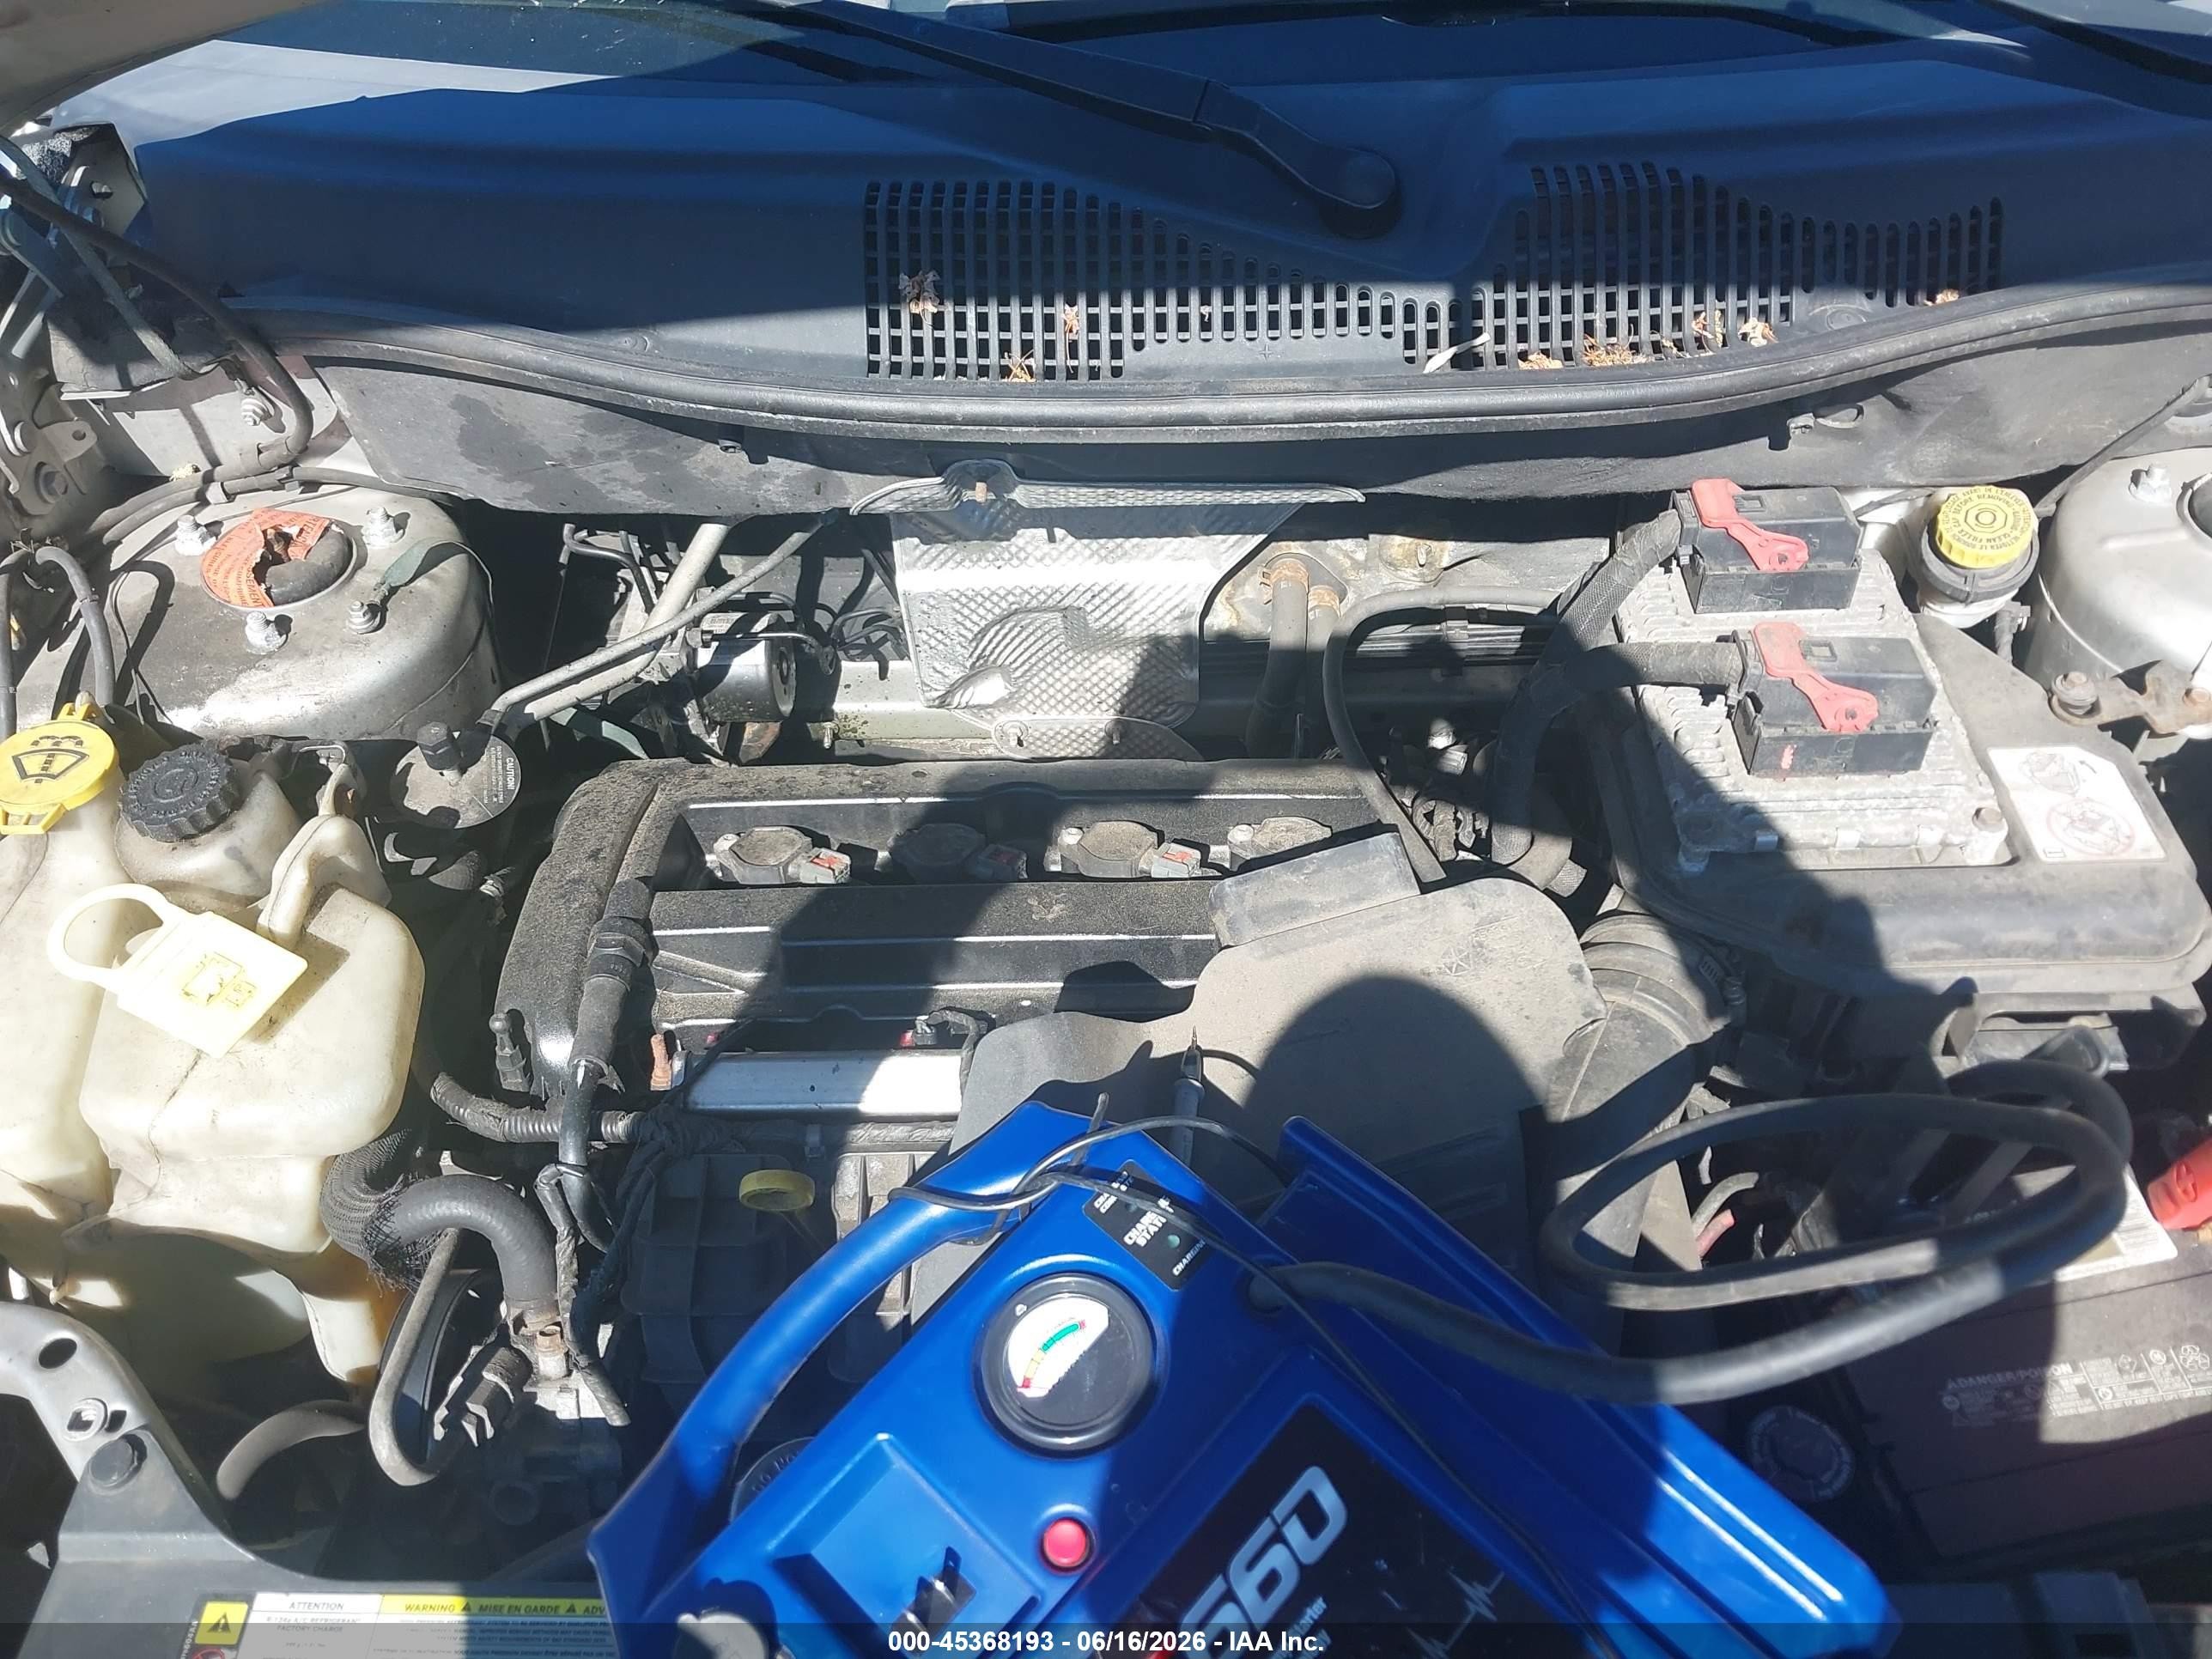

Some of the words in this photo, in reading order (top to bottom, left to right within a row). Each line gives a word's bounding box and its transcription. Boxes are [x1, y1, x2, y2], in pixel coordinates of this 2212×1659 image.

[506, 757, 515, 790] CAUTION!
[289, 1601, 344, 1611] ATTENTION
[404, 1603, 456, 1613] WARNING
[478, 1604, 505, 1613] MISE
[507, 1604, 521, 1614] EN
[524, 1604, 561, 1614] GARDE
[313, 1625, 343, 1633] CHARGE
